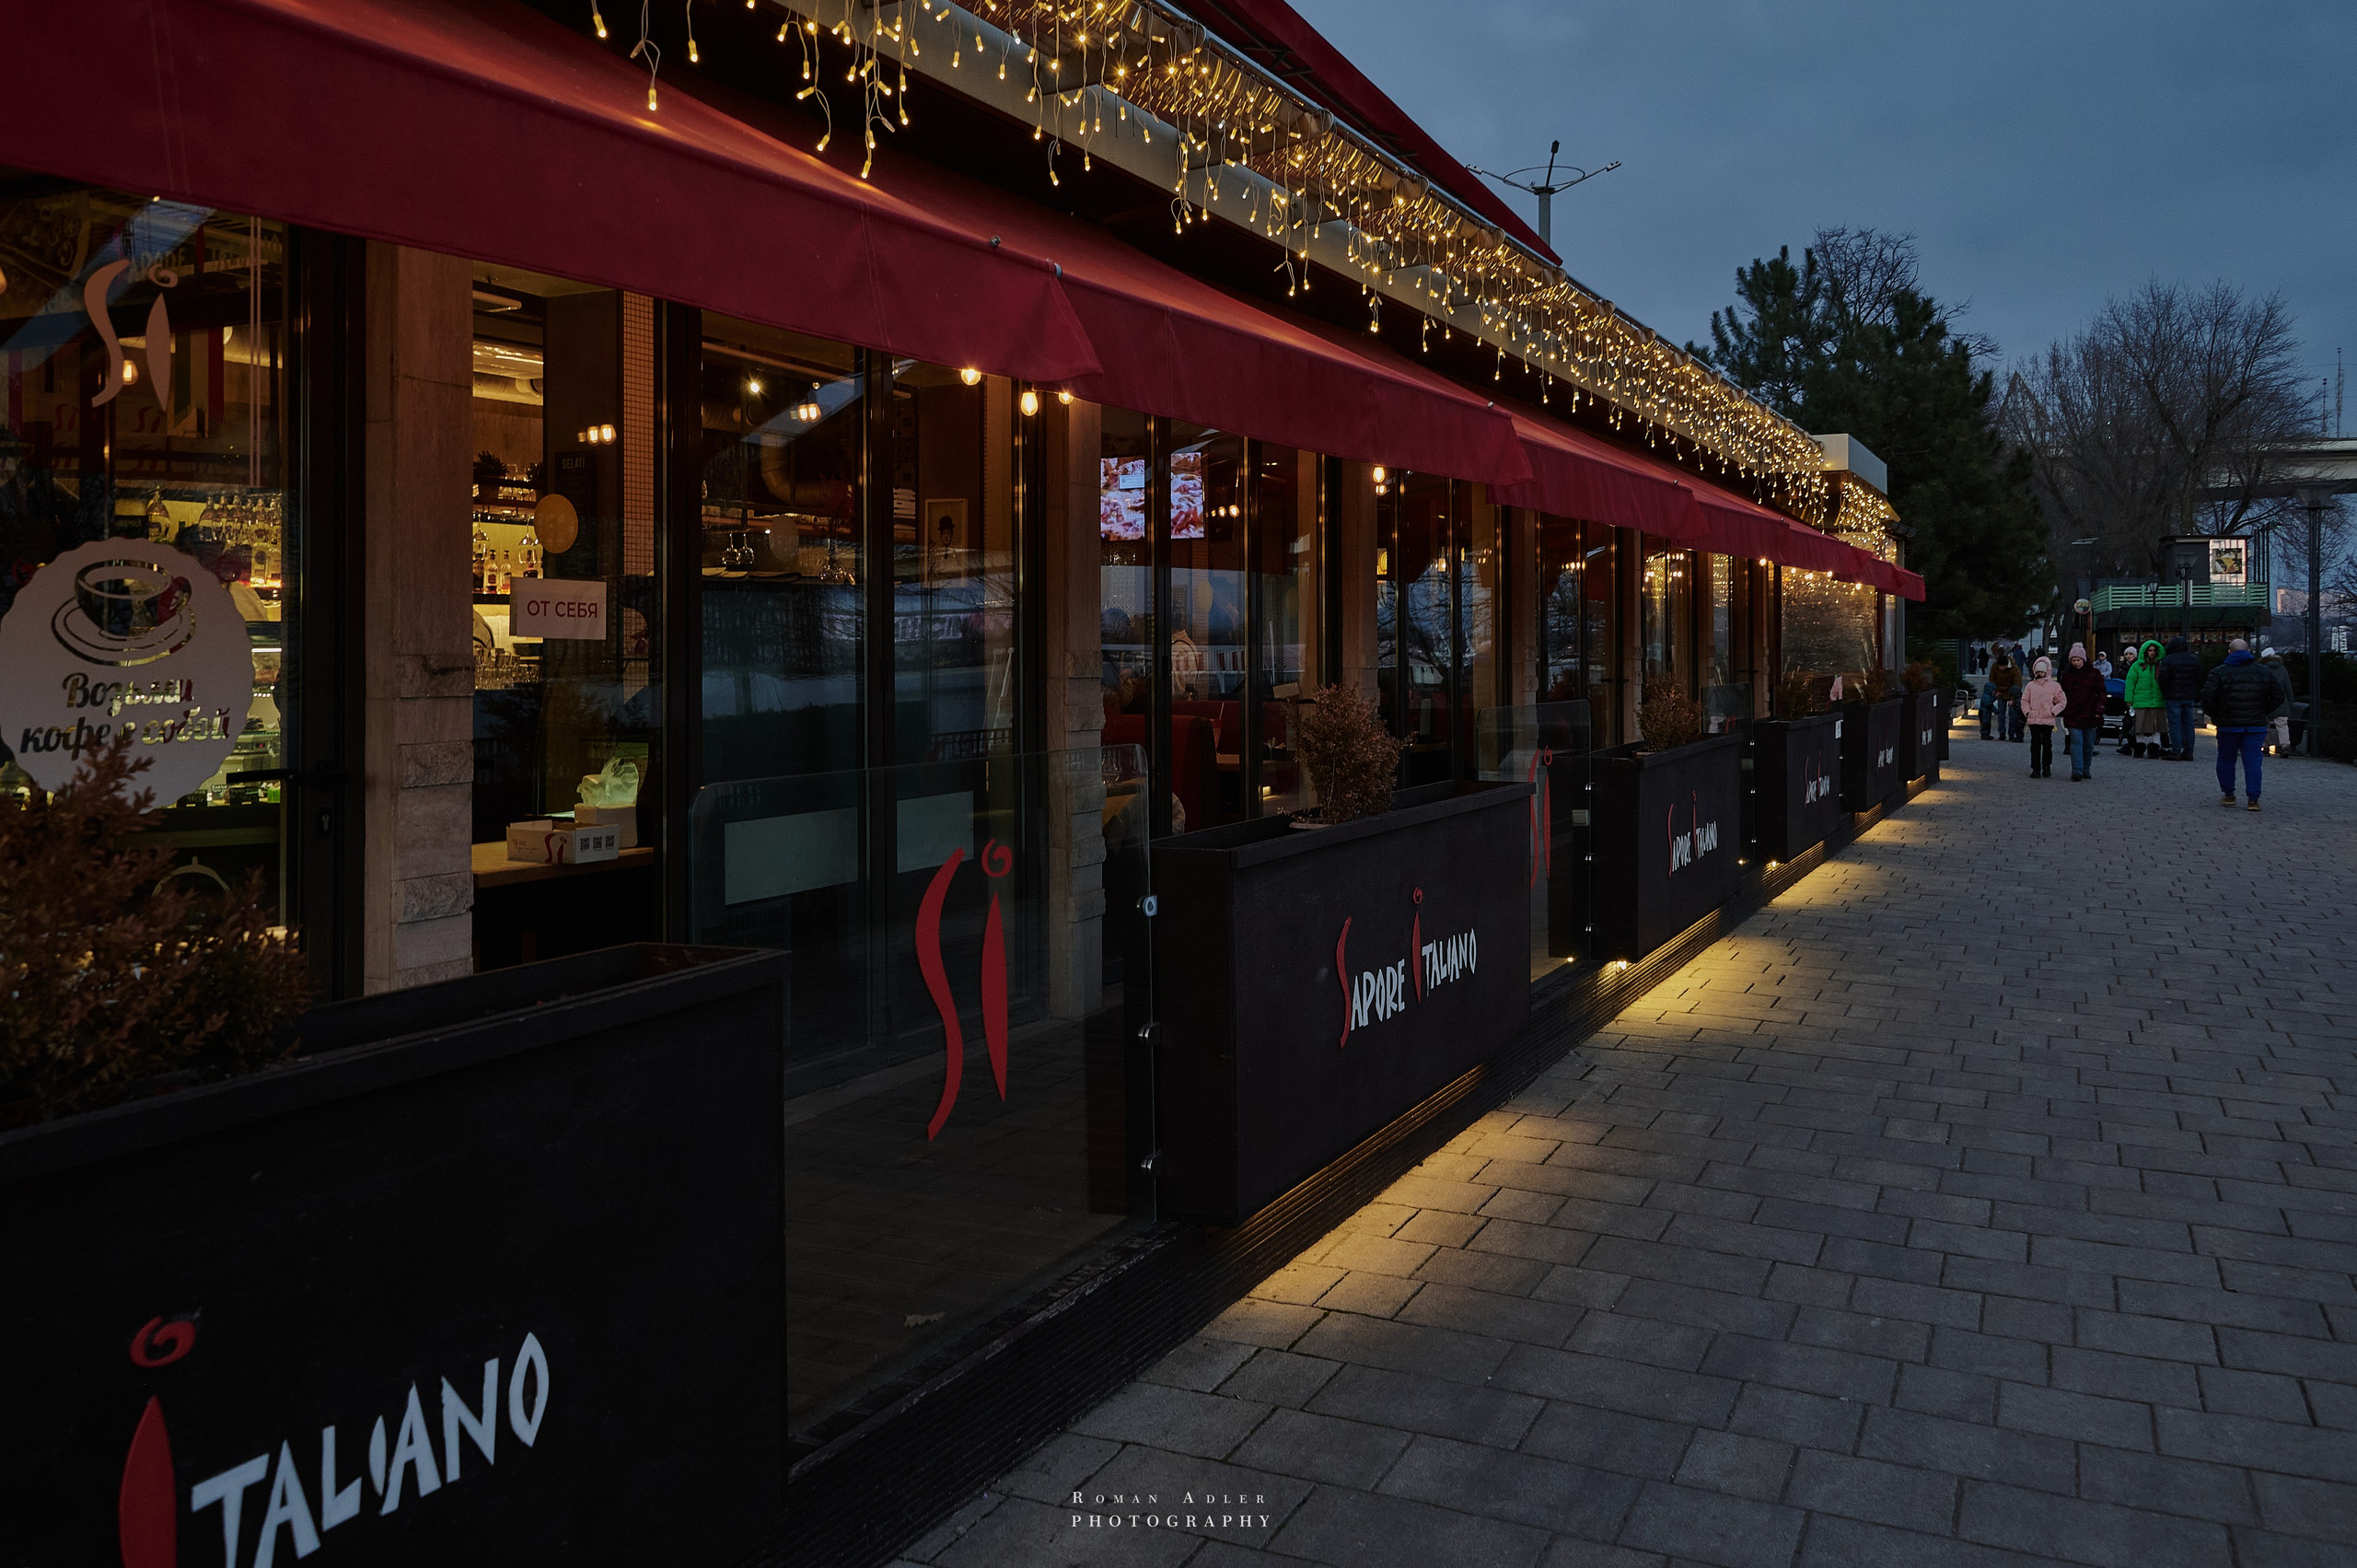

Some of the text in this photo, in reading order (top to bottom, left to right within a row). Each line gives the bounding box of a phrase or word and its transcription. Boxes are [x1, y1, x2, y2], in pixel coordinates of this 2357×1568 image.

[562, 458, 586, 470] GELATI
[527, 599, 598, 619] ОТ СЕБЯ
[62, 672, 193, 717] Возьми
[20, 716, 111, 761] кофе
[142, 706, 230, 745] собой
[1336, 915, 1407, 1049] SAPORE
